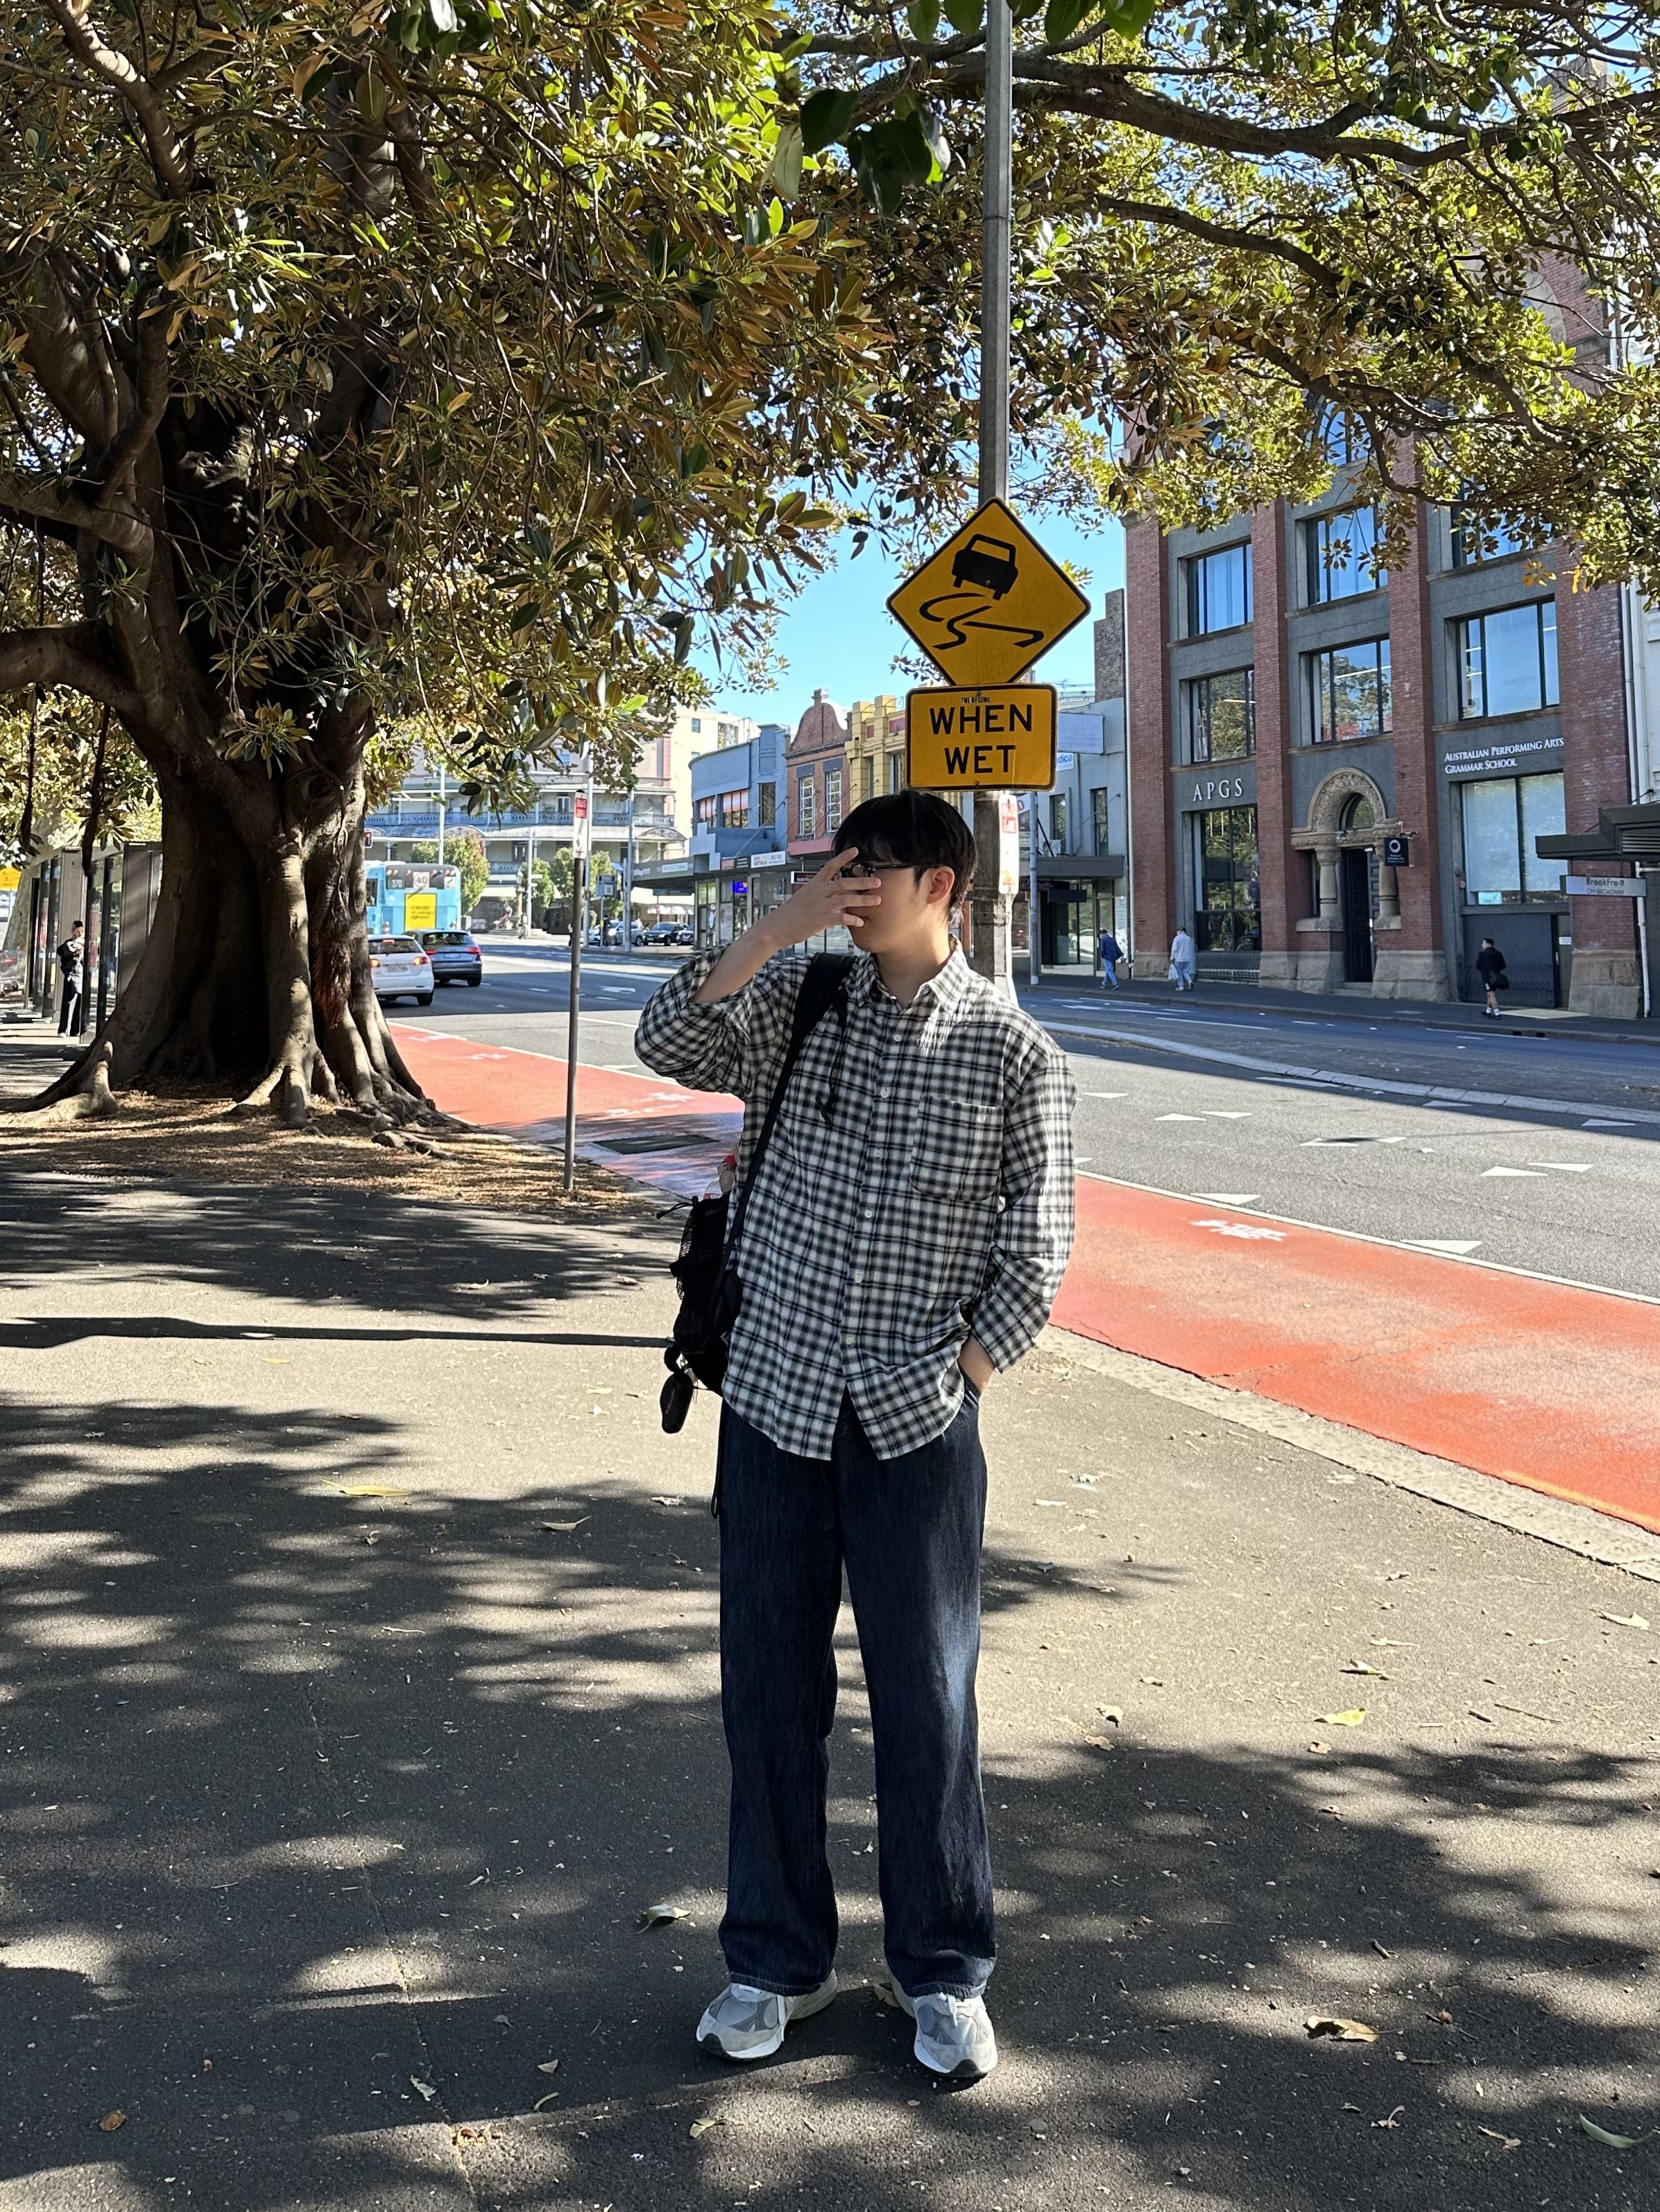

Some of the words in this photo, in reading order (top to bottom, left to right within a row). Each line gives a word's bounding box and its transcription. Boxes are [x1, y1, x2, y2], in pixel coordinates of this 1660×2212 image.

[930, 704, 1032, 735] WHEN
[944, 745, 1016, 775] WET
[1193, 778, 1243, 802] APGS
[391, 879, 402, 888] 370
[416, 876, 427, 884] 40
